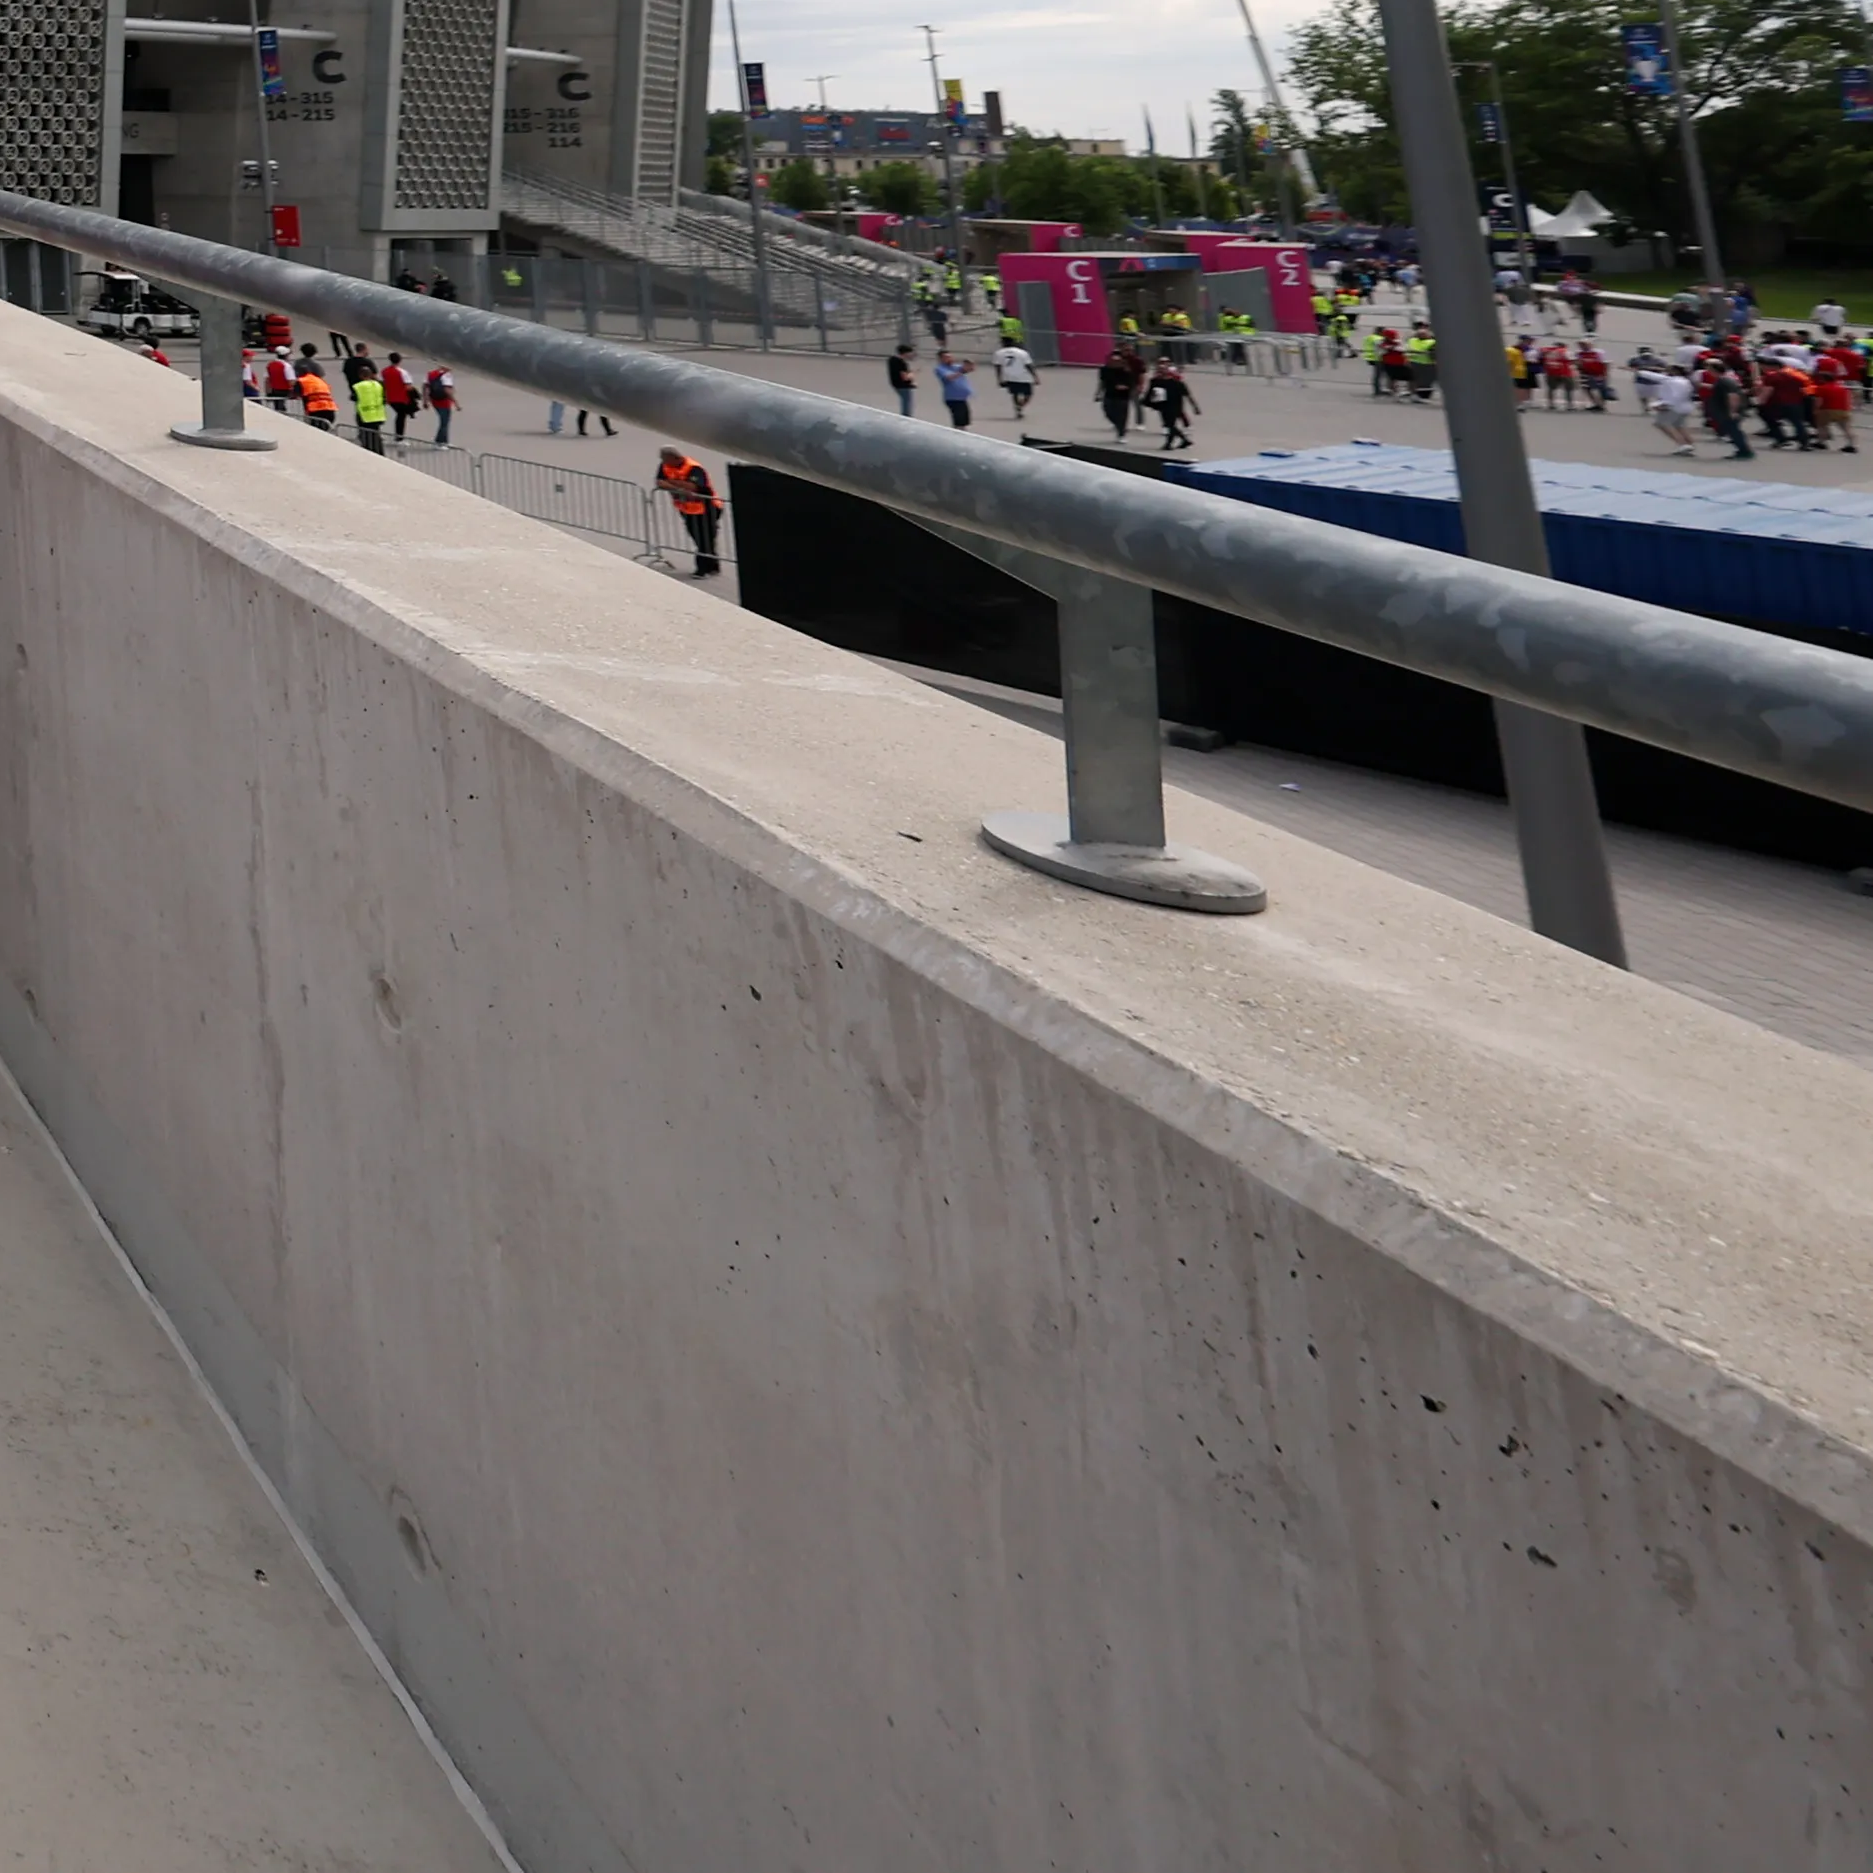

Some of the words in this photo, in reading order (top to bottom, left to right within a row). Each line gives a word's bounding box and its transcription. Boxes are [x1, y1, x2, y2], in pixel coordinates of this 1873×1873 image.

[313, 50, 347, 84] C
[558, 72, 592, 101] C
[1276, 250, 1300, 268] C
[1066, 260, 1092, 281] C
[1280, 269, 1301, 286] 2
[1071, 283, 1091, 304] 1
